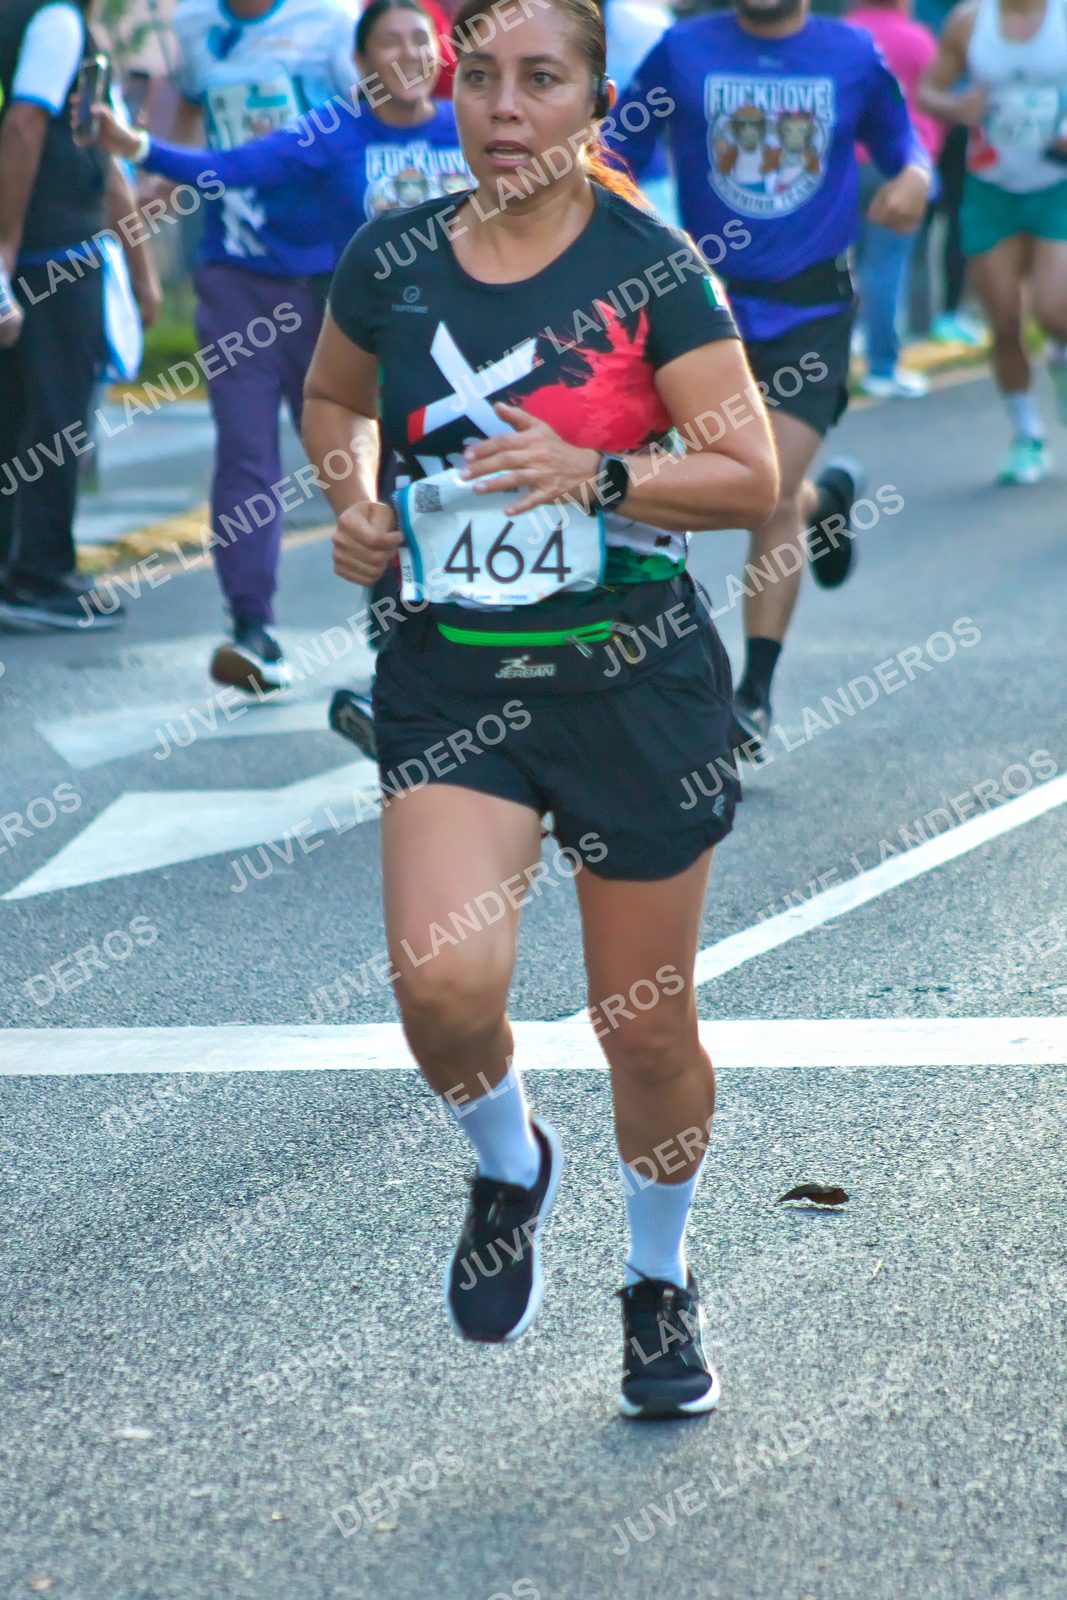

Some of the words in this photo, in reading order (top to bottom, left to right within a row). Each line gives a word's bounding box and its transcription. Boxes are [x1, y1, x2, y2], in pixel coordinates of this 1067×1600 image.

[709, 78, 831, 124] FUCKLOVE
[370, 147, 467, 178] FUCKLOV
[442, 520, 573, 585] 464
